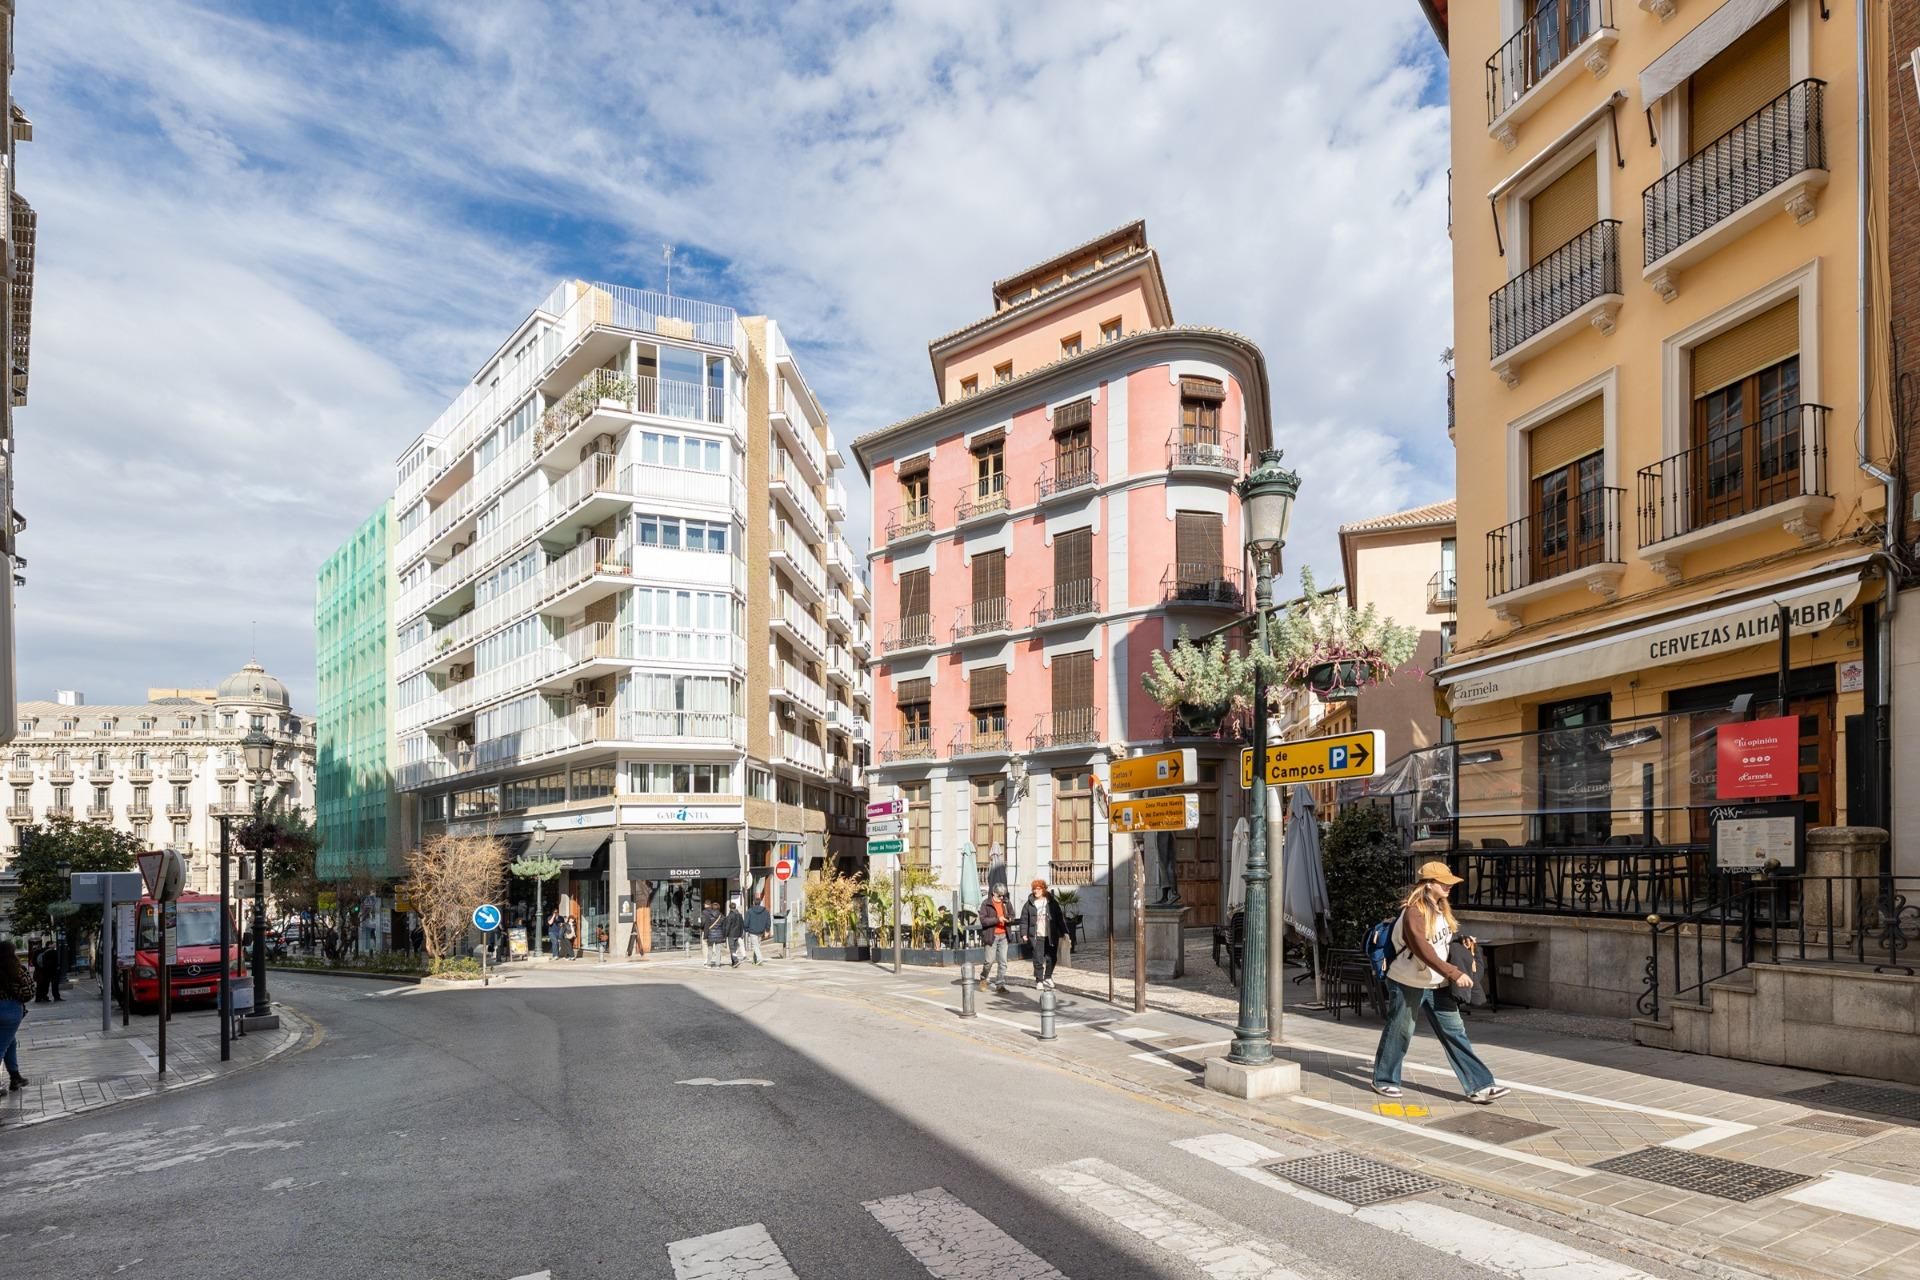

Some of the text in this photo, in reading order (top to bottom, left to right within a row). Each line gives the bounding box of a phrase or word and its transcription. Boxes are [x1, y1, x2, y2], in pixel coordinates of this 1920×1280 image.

[1650, 598, 1844, 659] CERVEZAS ALHAMBRA
[1454, 682, 1499, 700] Carmela
[1275, 751, 1288, 762] de
[1271, 763, 1325, 779] Campos
[1738, 772, 1773, 782] Carmela
[670, 869, 701, 877] BONGO
